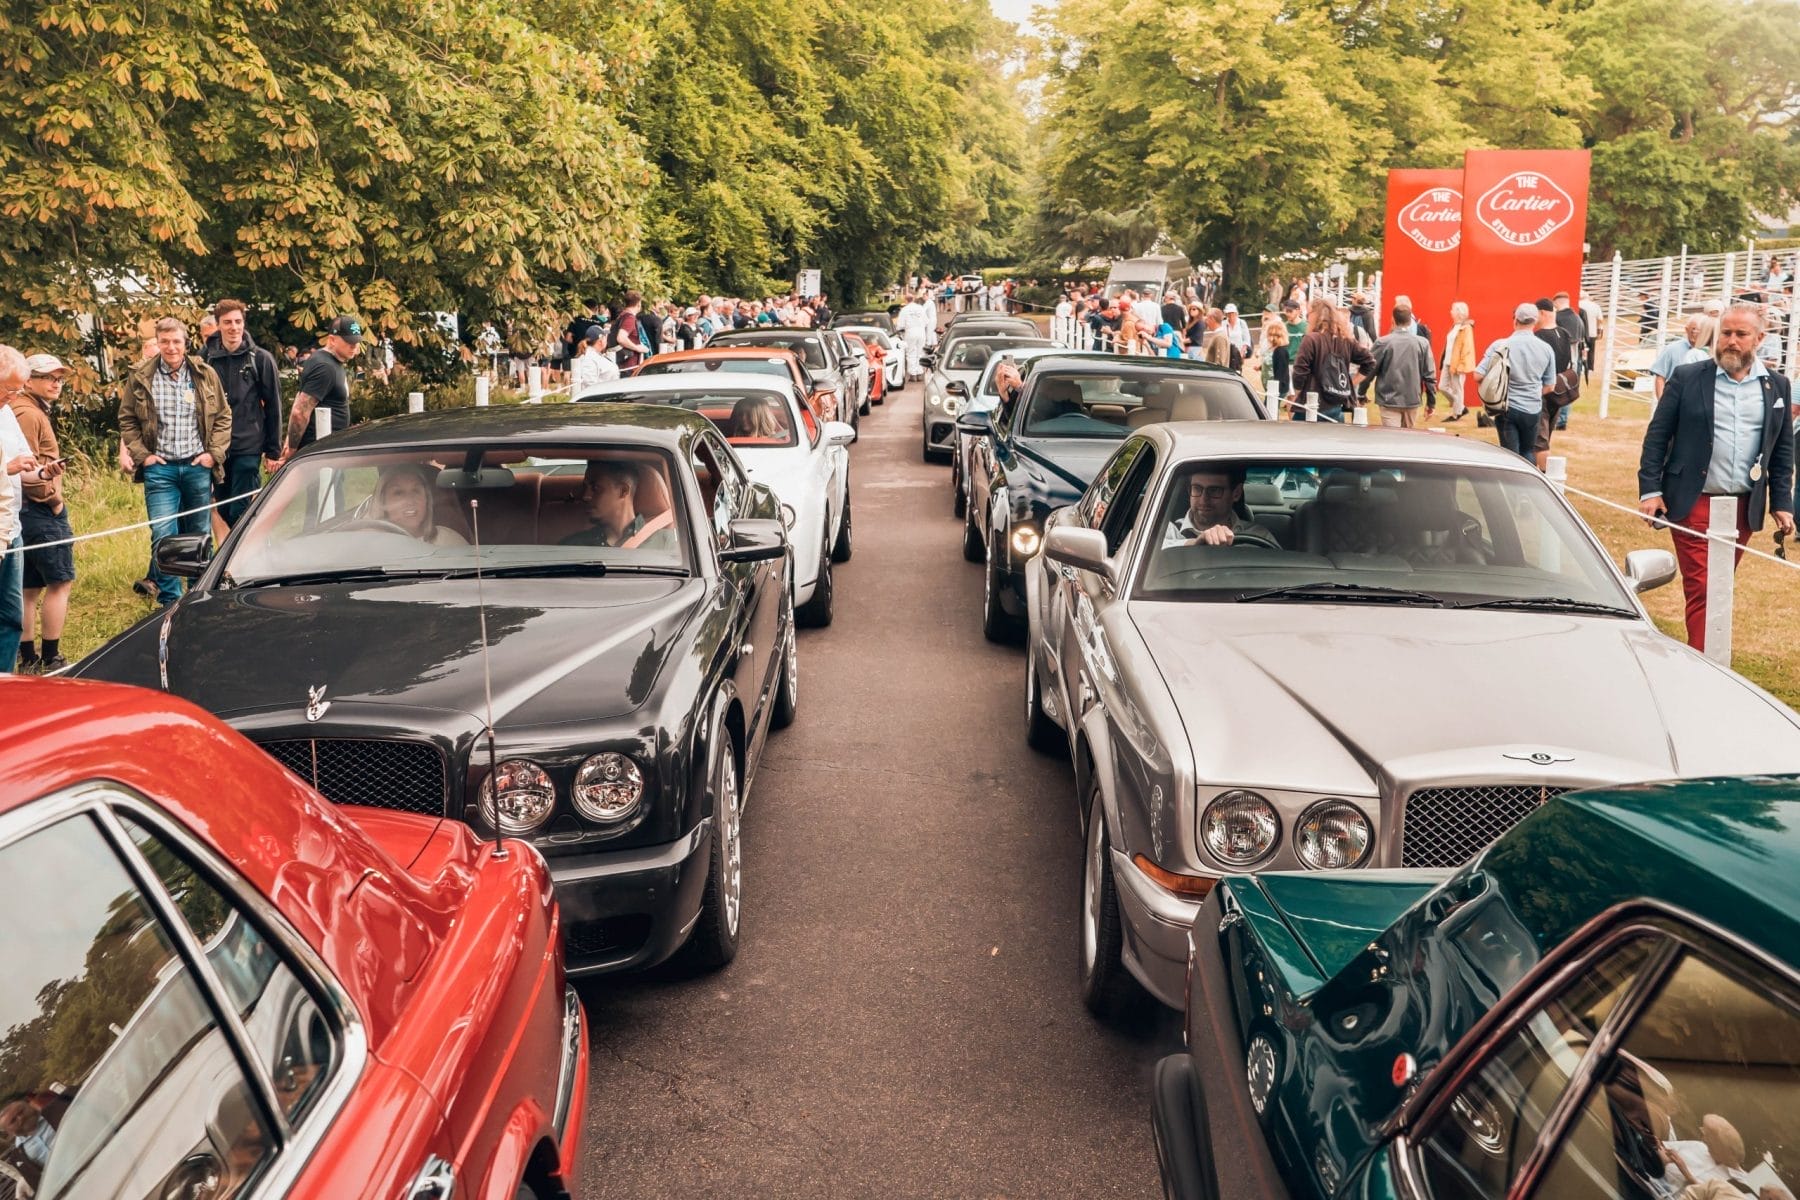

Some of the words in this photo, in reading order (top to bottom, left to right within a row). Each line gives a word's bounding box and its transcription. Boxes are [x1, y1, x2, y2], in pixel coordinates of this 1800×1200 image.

[1516, 176, 1539, 189] THE
[1431, 191, 1451, 203] THE
[1490, 190, 1561, 211] Cartier
[1409, 203, 1462, 222] Cartie
[1410, 228, 1434, 247] STYLE
[1434, 240, 1446, 249] ET
[1446, 230, 1461, 246] LUX
[1491, 218, 1518, 241] STYLE
[1519, 233, 1531, 242] ET
[1533, 218, 1557, 240] LUXE
